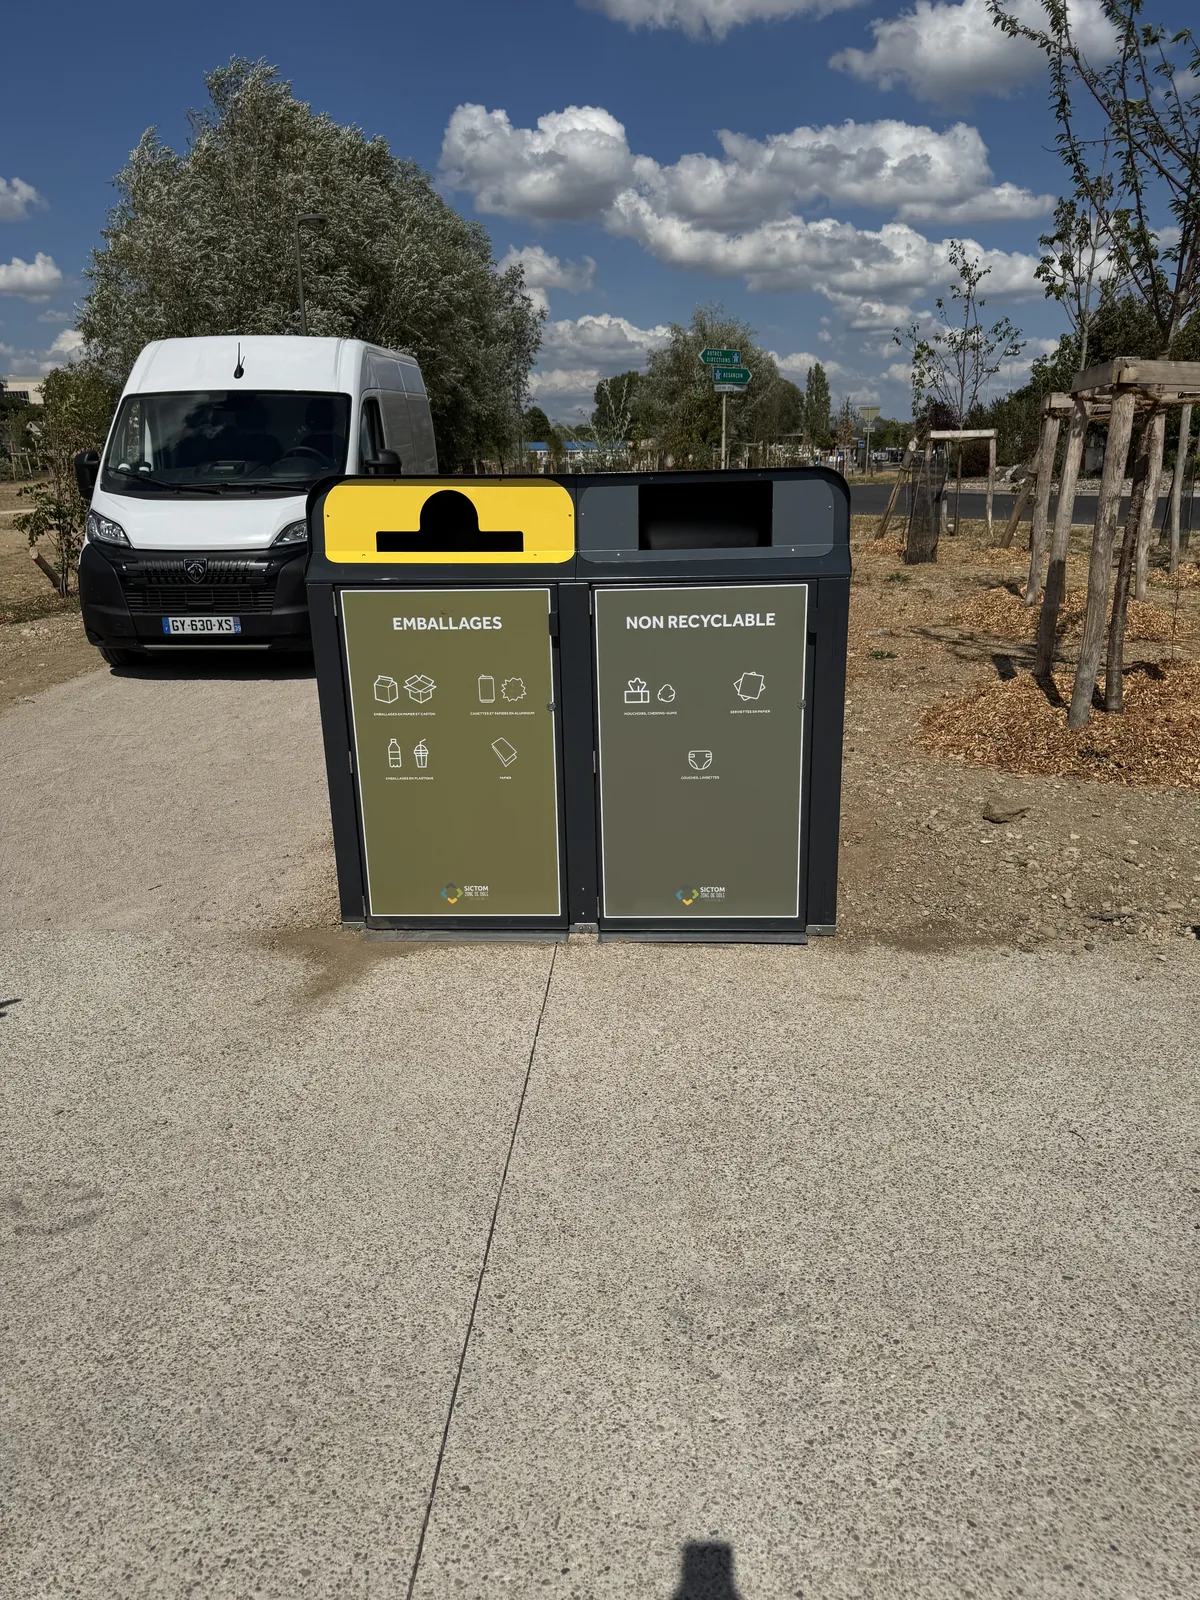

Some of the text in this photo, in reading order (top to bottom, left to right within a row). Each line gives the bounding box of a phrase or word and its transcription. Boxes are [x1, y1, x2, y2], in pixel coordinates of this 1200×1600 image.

[171, 619, 232, 632] GY-630-XS
[392, 616, 503, 630] EMBALLAGES
[626, 612, 776, 630] NON RECYCLABLE
